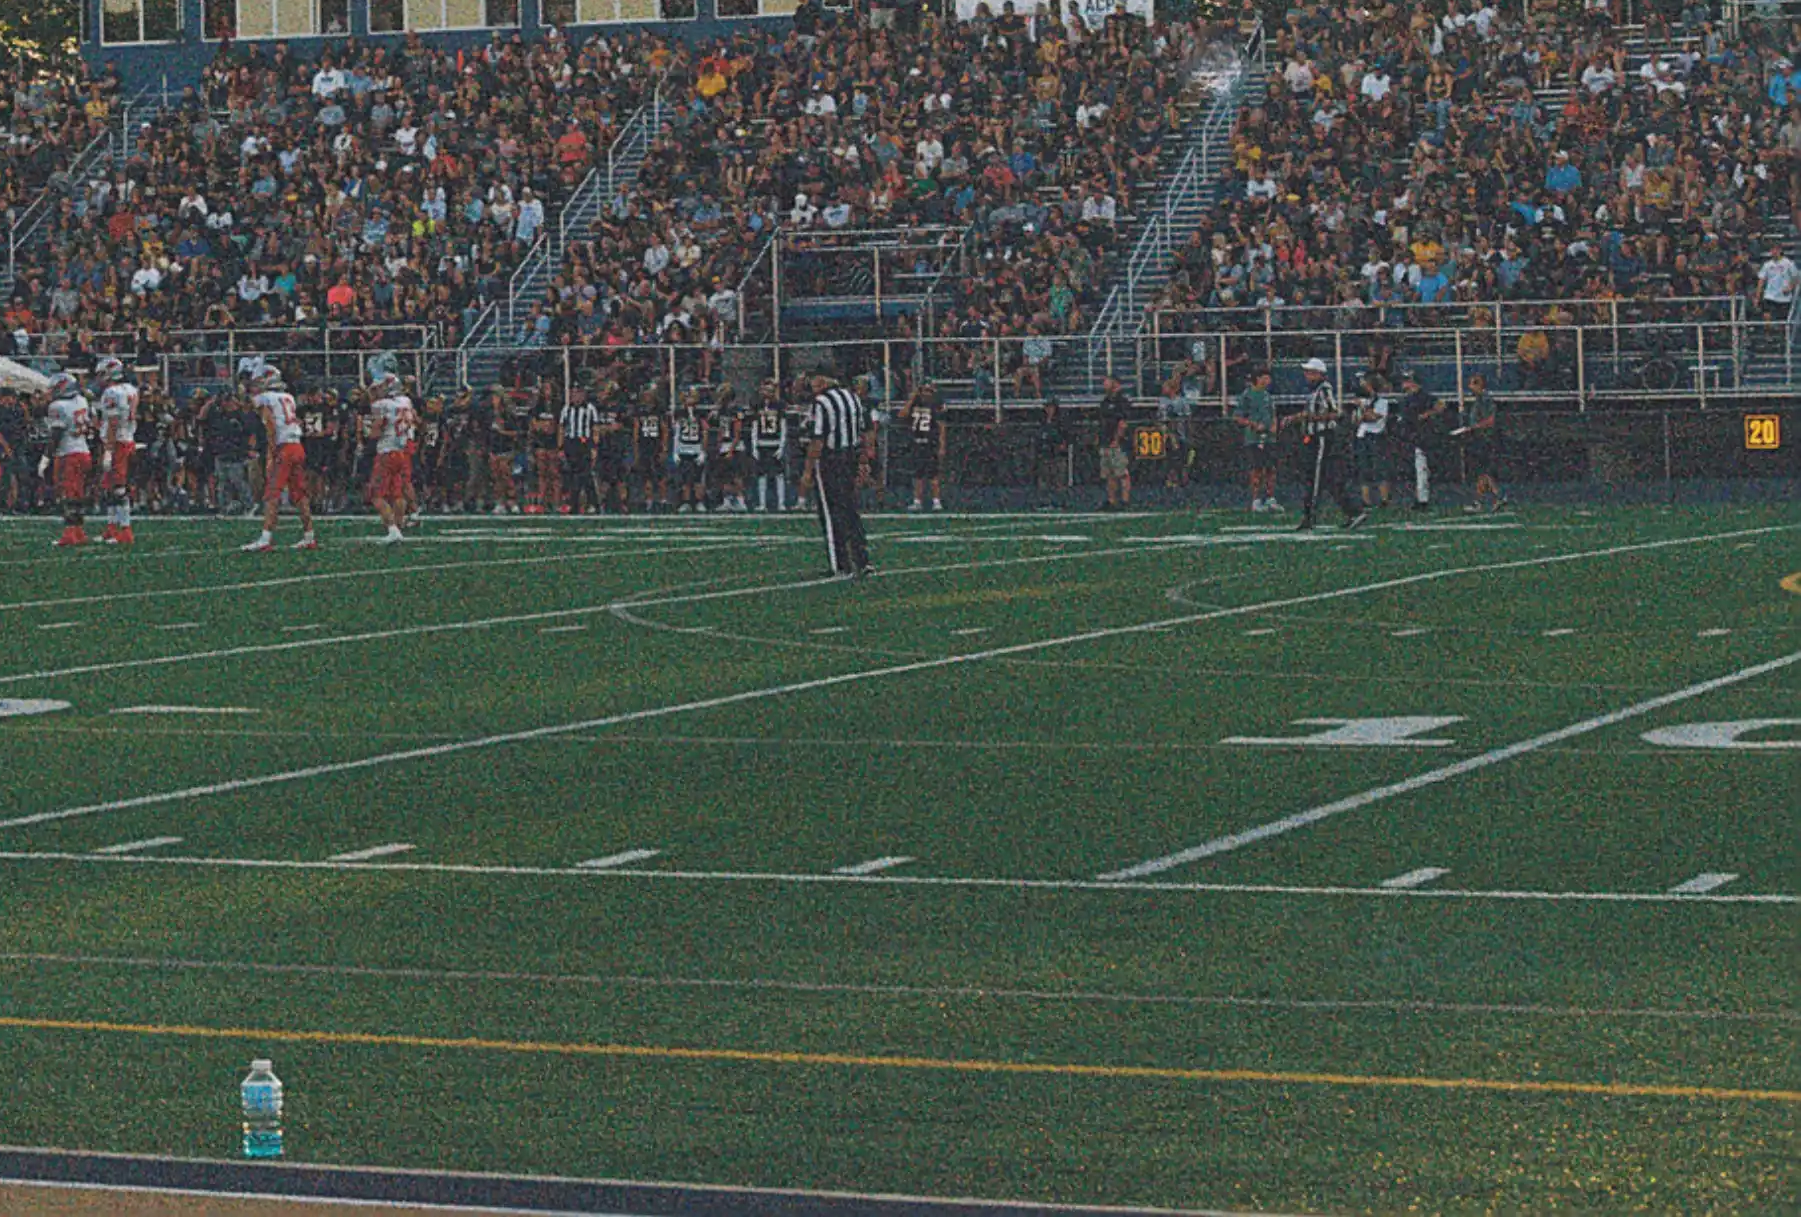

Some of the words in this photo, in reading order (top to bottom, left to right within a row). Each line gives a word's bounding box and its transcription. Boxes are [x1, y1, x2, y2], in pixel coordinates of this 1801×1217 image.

[761, 415, 778, 433] 13
[911, 412, 932, 432] 72
[1749, 420, 1775, 444] 20
[1138, 431, 1163, 455] 30
